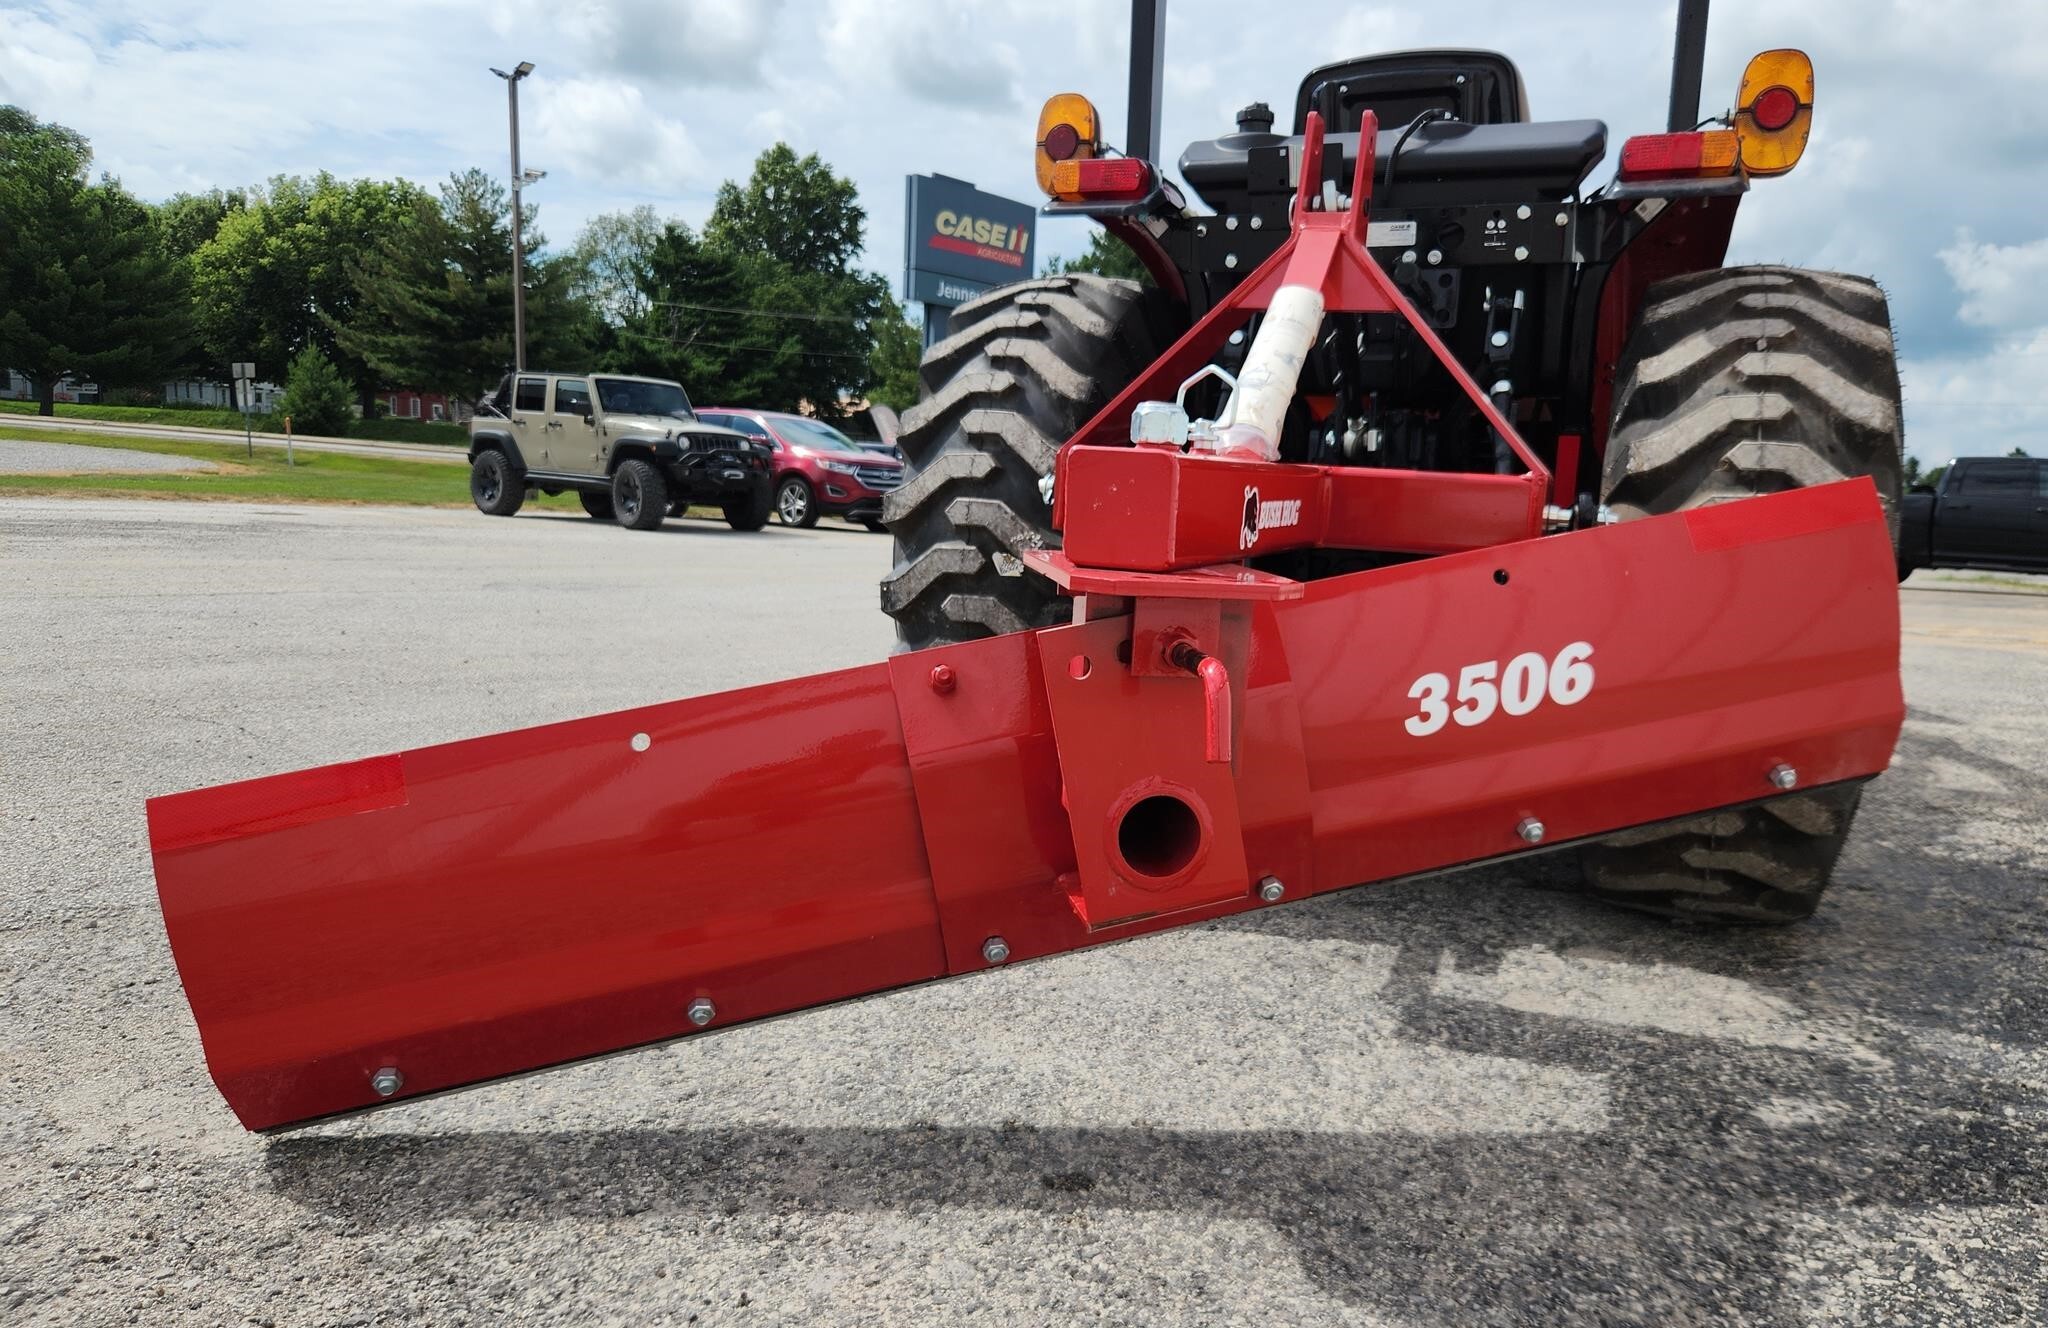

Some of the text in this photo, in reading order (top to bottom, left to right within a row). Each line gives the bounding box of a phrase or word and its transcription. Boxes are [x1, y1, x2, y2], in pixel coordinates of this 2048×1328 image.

[936, 211, 1008, 248] CASE
[1258, 500, 1301, 529] BUSH HOG
[1404, 641, 1595, 737] 3506
